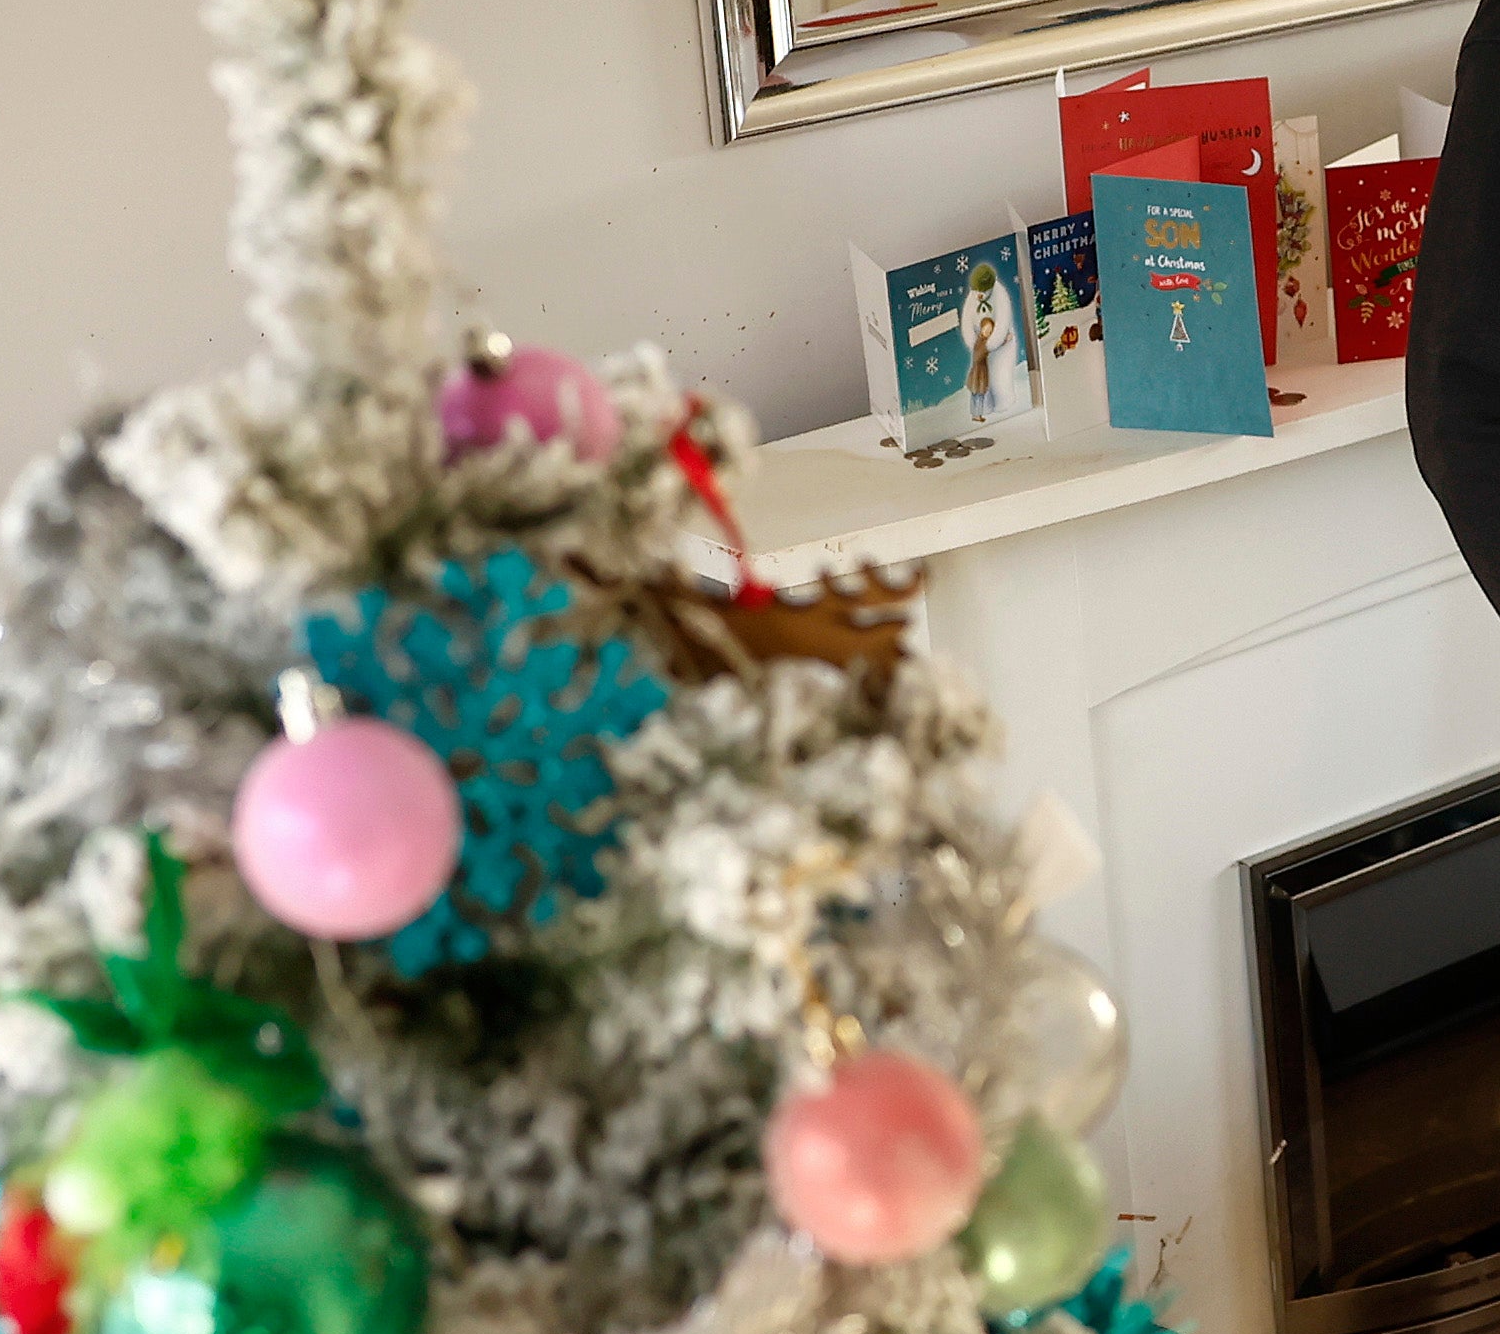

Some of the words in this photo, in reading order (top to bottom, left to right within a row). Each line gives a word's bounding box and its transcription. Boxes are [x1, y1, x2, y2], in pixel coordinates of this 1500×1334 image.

[1201, 125, 1262, 146] HUSBAND
[1147, 205, 1161, 216] FOR
[1163, 207, 1169, 216] A
[1169, 207, 1194, 219] SPECIAL
[1033, 223, 1076, 245] MERRY
[1144, 218, 1201, 249] SON
[1033, 234, 1095, 260] CHRISTMA
[1350, 237, 1420, 275] Wonde
[1144, 254, 1156, 268] at
[1157, 254, 1206, 272] Christmas
[909, 301, 944, 323] Merry
